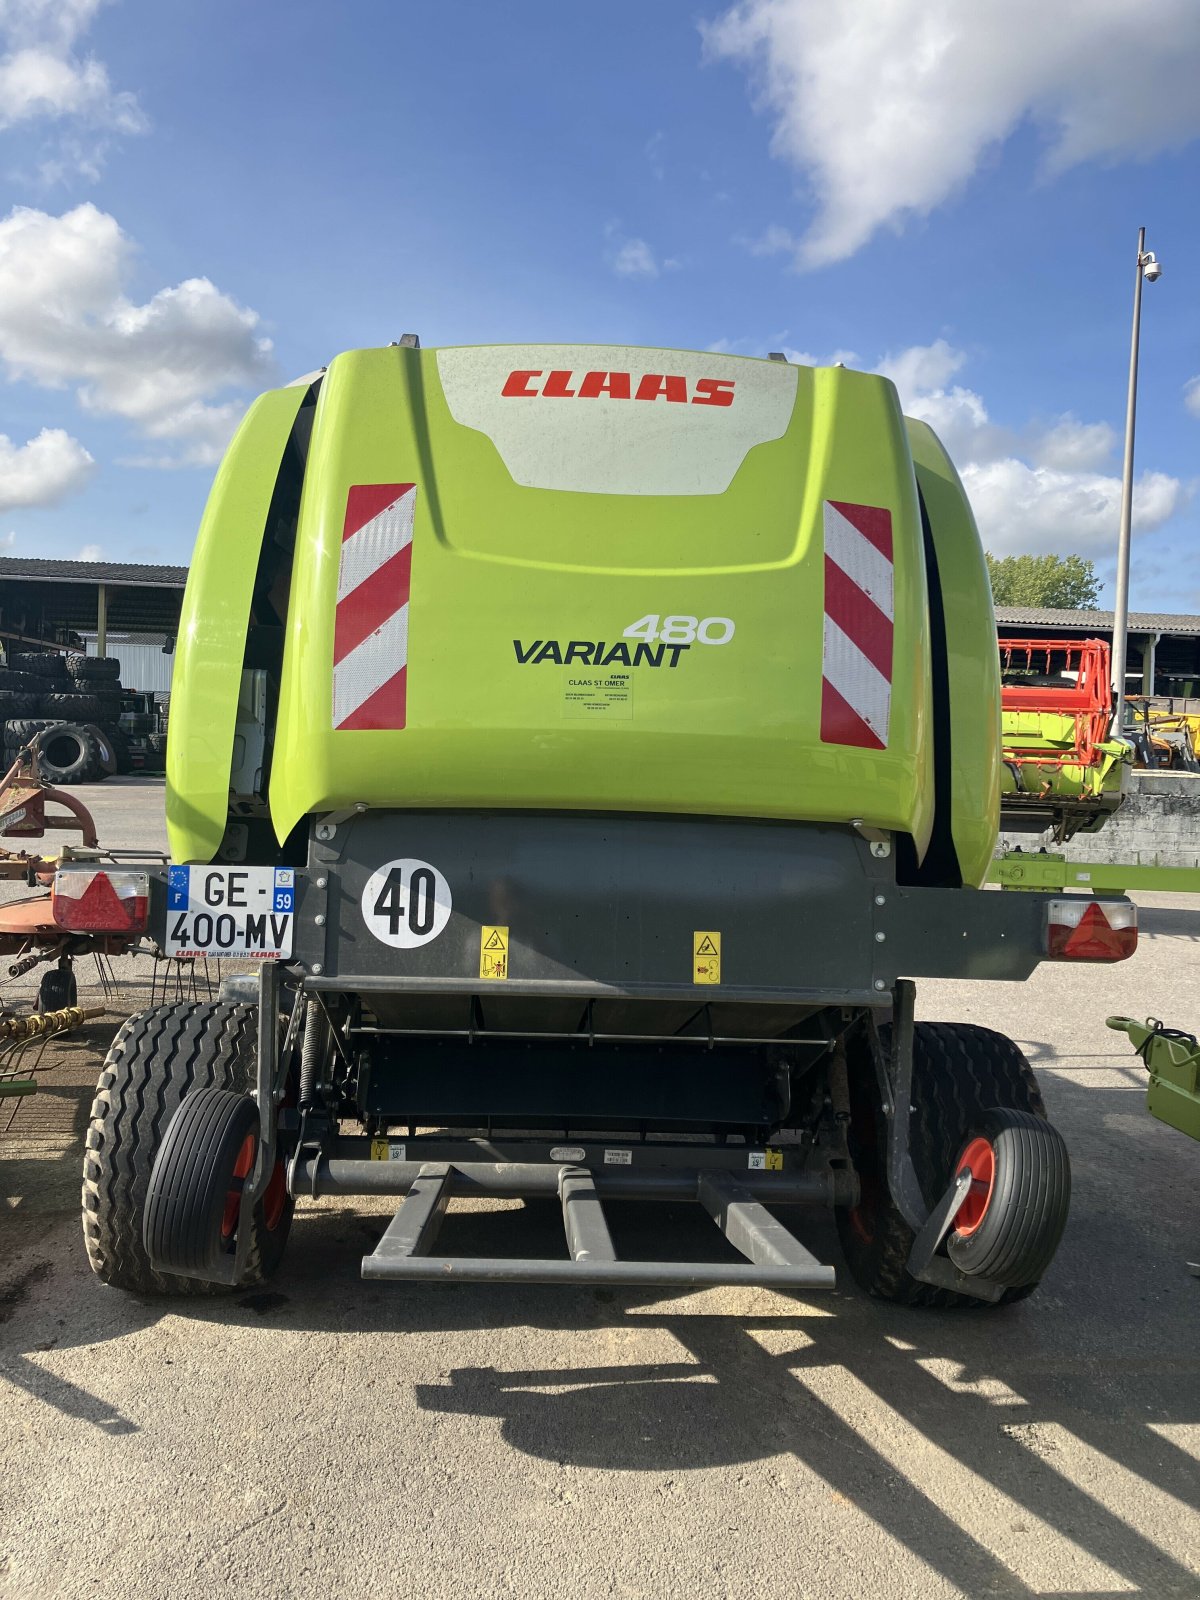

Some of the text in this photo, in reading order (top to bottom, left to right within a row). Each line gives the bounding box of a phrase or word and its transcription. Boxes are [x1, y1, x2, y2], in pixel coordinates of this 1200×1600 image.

[501, 370, 736, 407] CLAAS
[622, 614, 736, 645] 480
[512, 639, 691, 668] VARIANT
[174, 893, 182, 904] F
[276, 893, 292, 910] 59
[373, 867, 436, 936] 40
[170, 912, 290, 949] 400-MV
